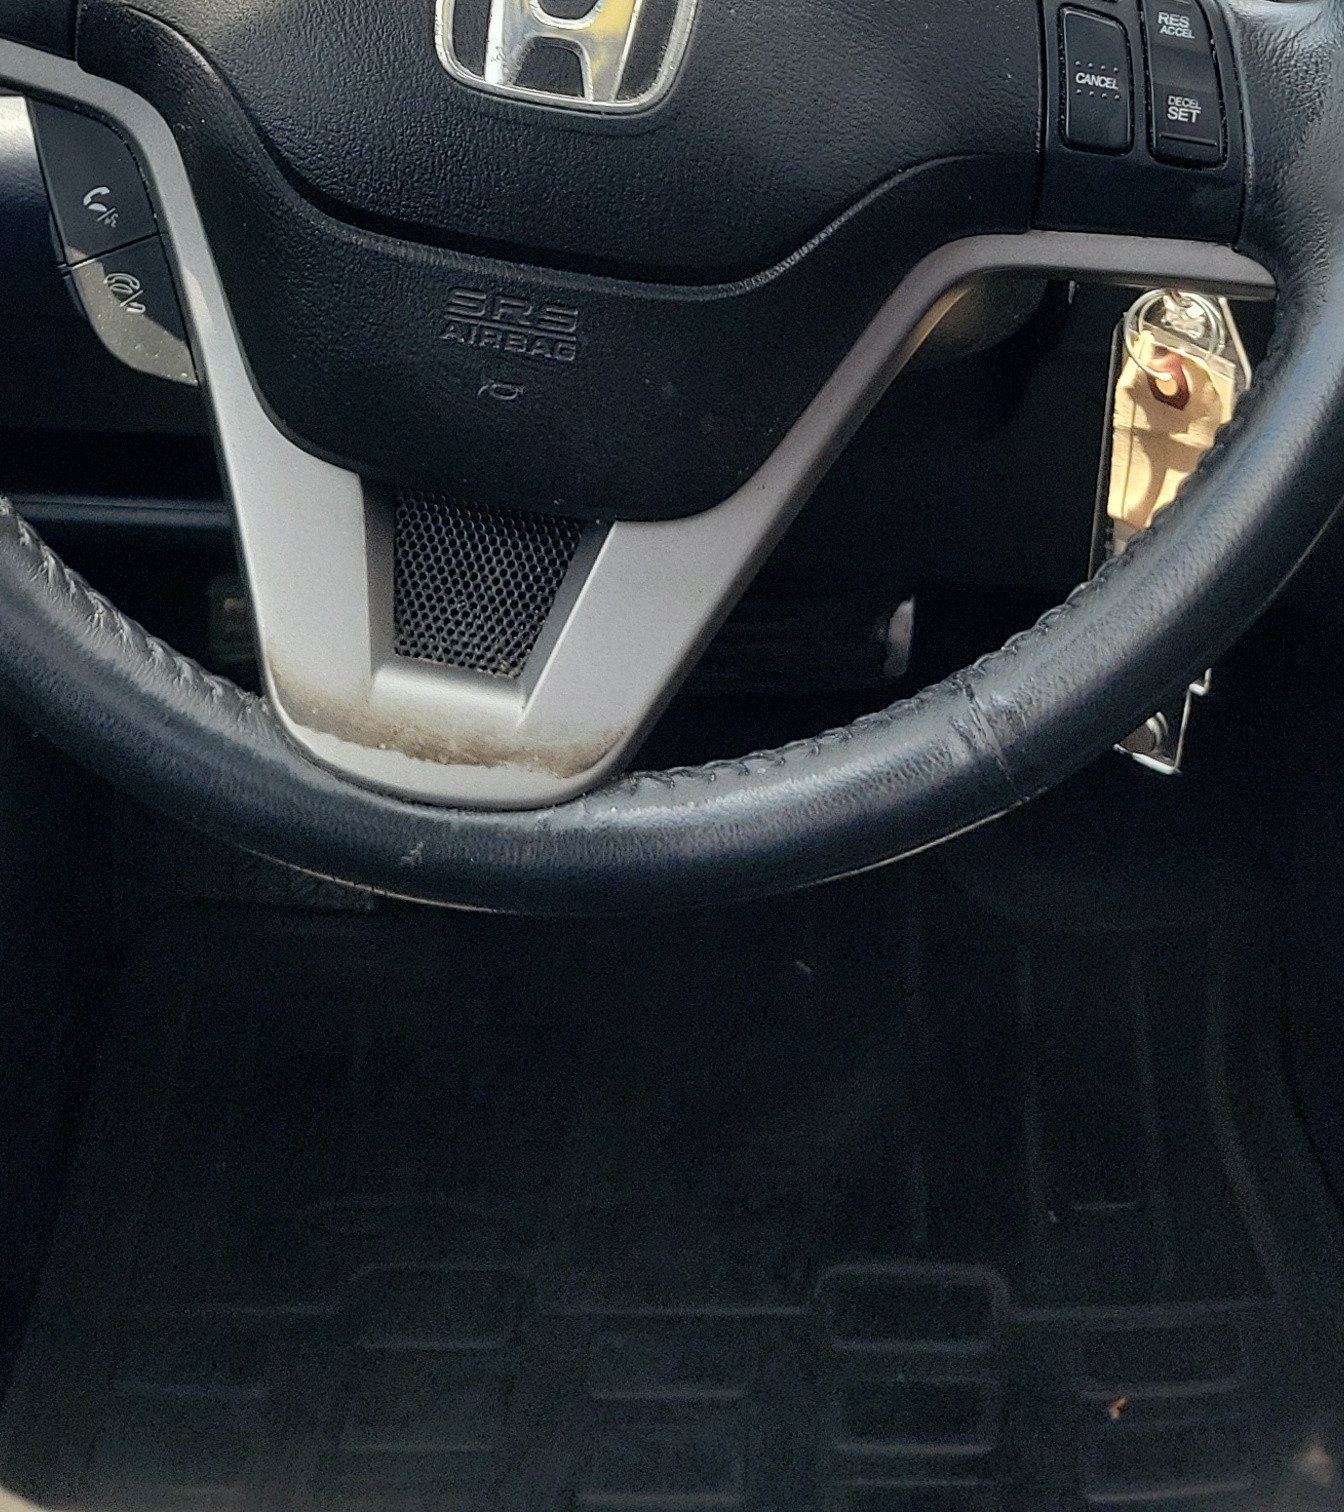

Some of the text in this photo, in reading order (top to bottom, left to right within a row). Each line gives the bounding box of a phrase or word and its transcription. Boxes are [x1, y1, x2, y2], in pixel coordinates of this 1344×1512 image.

[1158, 11, 1191, 27] RES
[1159, 25, 1195, 39] ACCEL
[1075, 72, 1120, 90] CANCEL
[1168, 95, 1202, 110] DECEL
[1167, 106, 1201, 123] SET
[439, 324, 577, 362] AIRBAG
